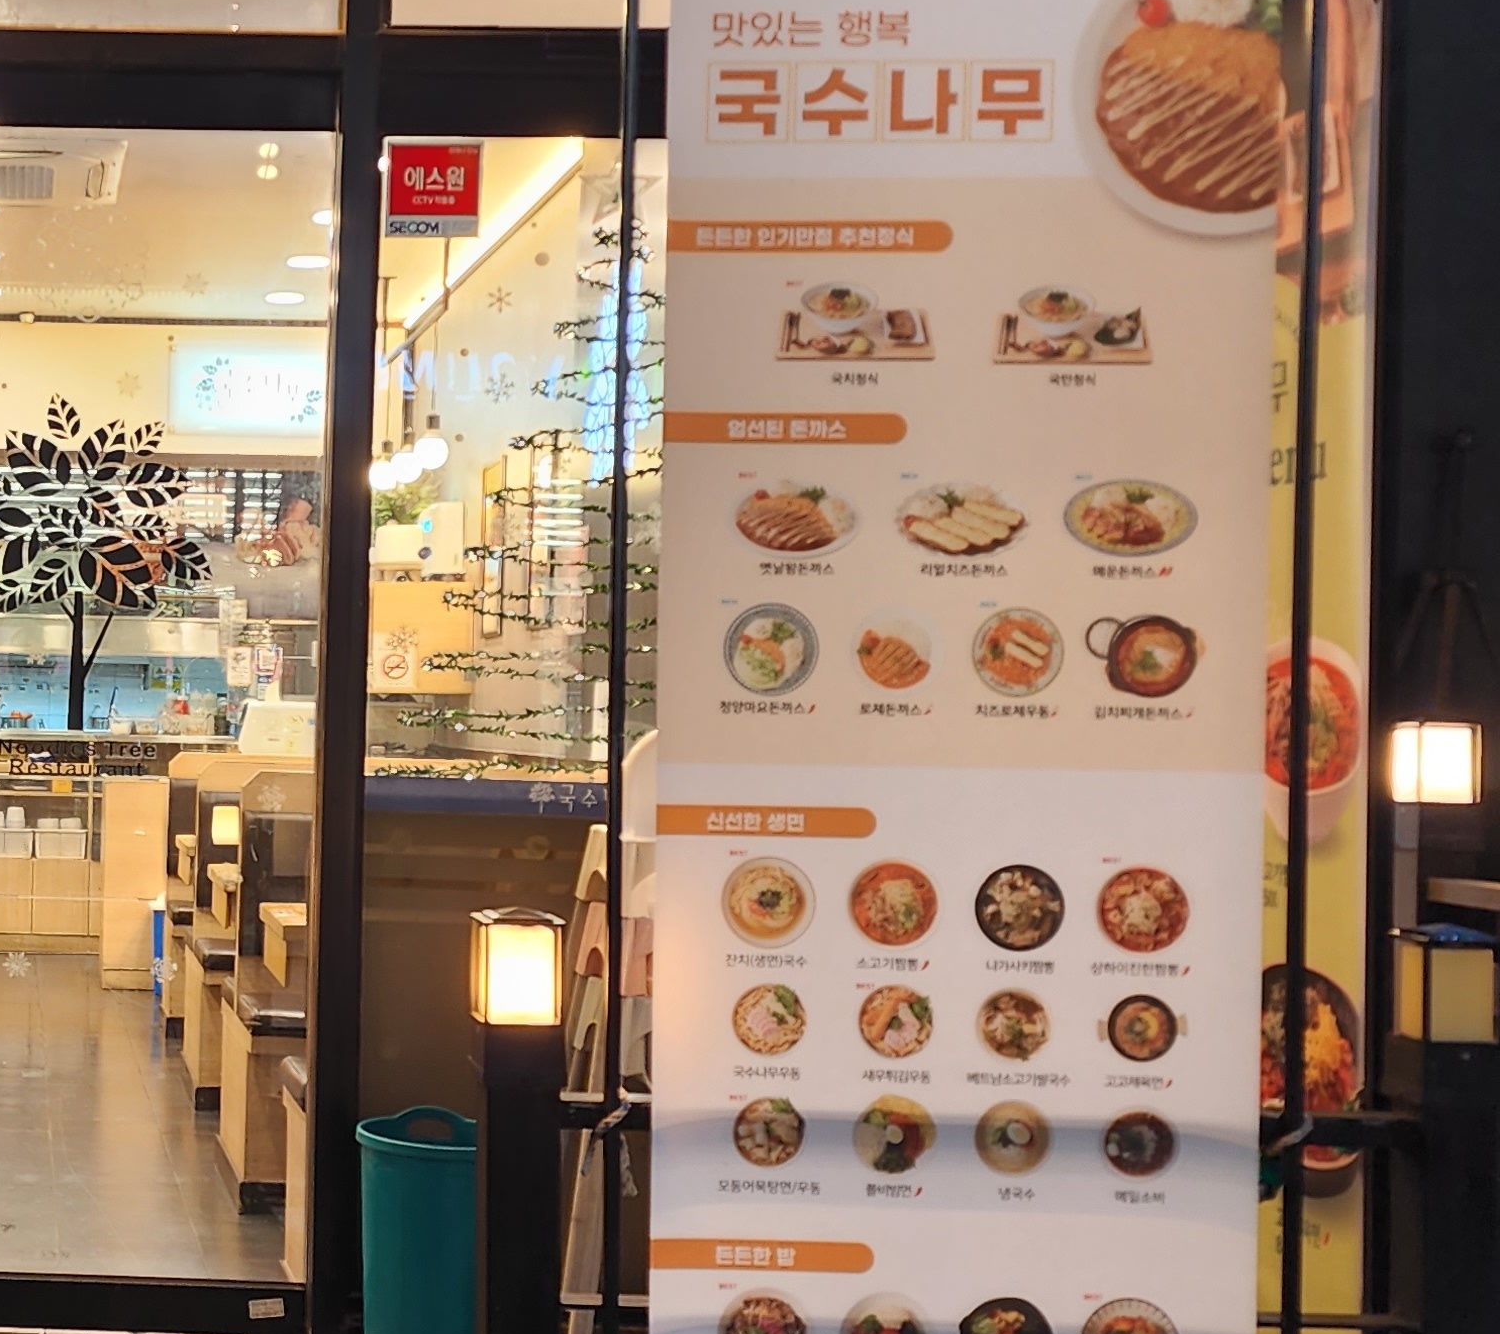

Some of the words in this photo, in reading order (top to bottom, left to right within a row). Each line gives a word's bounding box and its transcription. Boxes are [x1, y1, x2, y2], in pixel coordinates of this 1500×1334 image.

[711, 9, 824, 49] 맛있는
[837, 9, 912, 48] 행복
[714, 67, 1046, 138] 국수나무
[403, 165, 466, 192] 에스원
[388, 220, 440, 235] SECOM
[696, 225, 752, 248] 든든한
[789, 418, 848, 440] 돈까스
[105, 741, 158, 760] Tree
[8, 759, 146, 777] Restaurant
[706, 811, 762, 833] 신선한
[766, 812, 806, 834] 생면
[724, 953, 808, 969] 잔치(생면)국수
